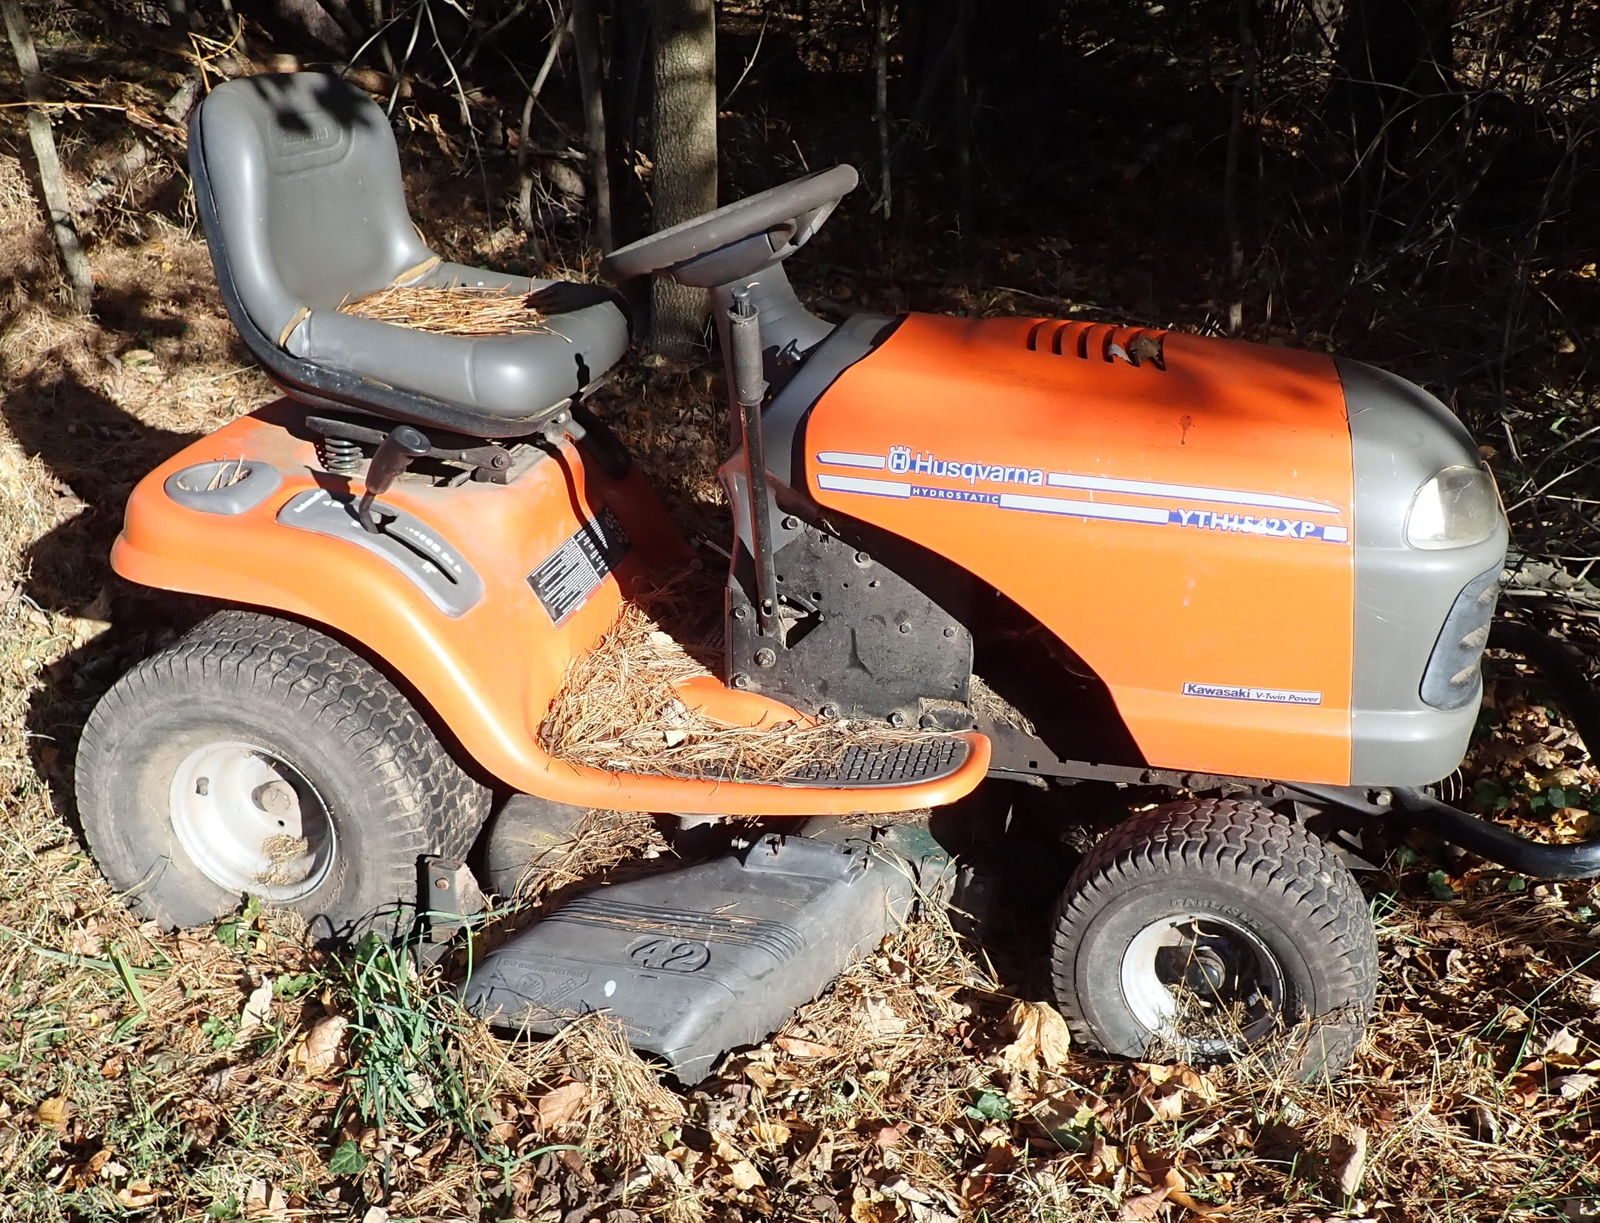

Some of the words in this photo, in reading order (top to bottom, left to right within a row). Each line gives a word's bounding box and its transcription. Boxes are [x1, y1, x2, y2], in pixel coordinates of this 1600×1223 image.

[915, 453, 1044, 486] Husqvarna
[912, 487, 1000, 504] HYDROSTATIC
[1187, 684, 1251, 699] Kawasaki
[1255, 690, 1286, 701] V-Twin
[1287, 694, 1319, 704] Power
[630, 938, 709, 972] 42
